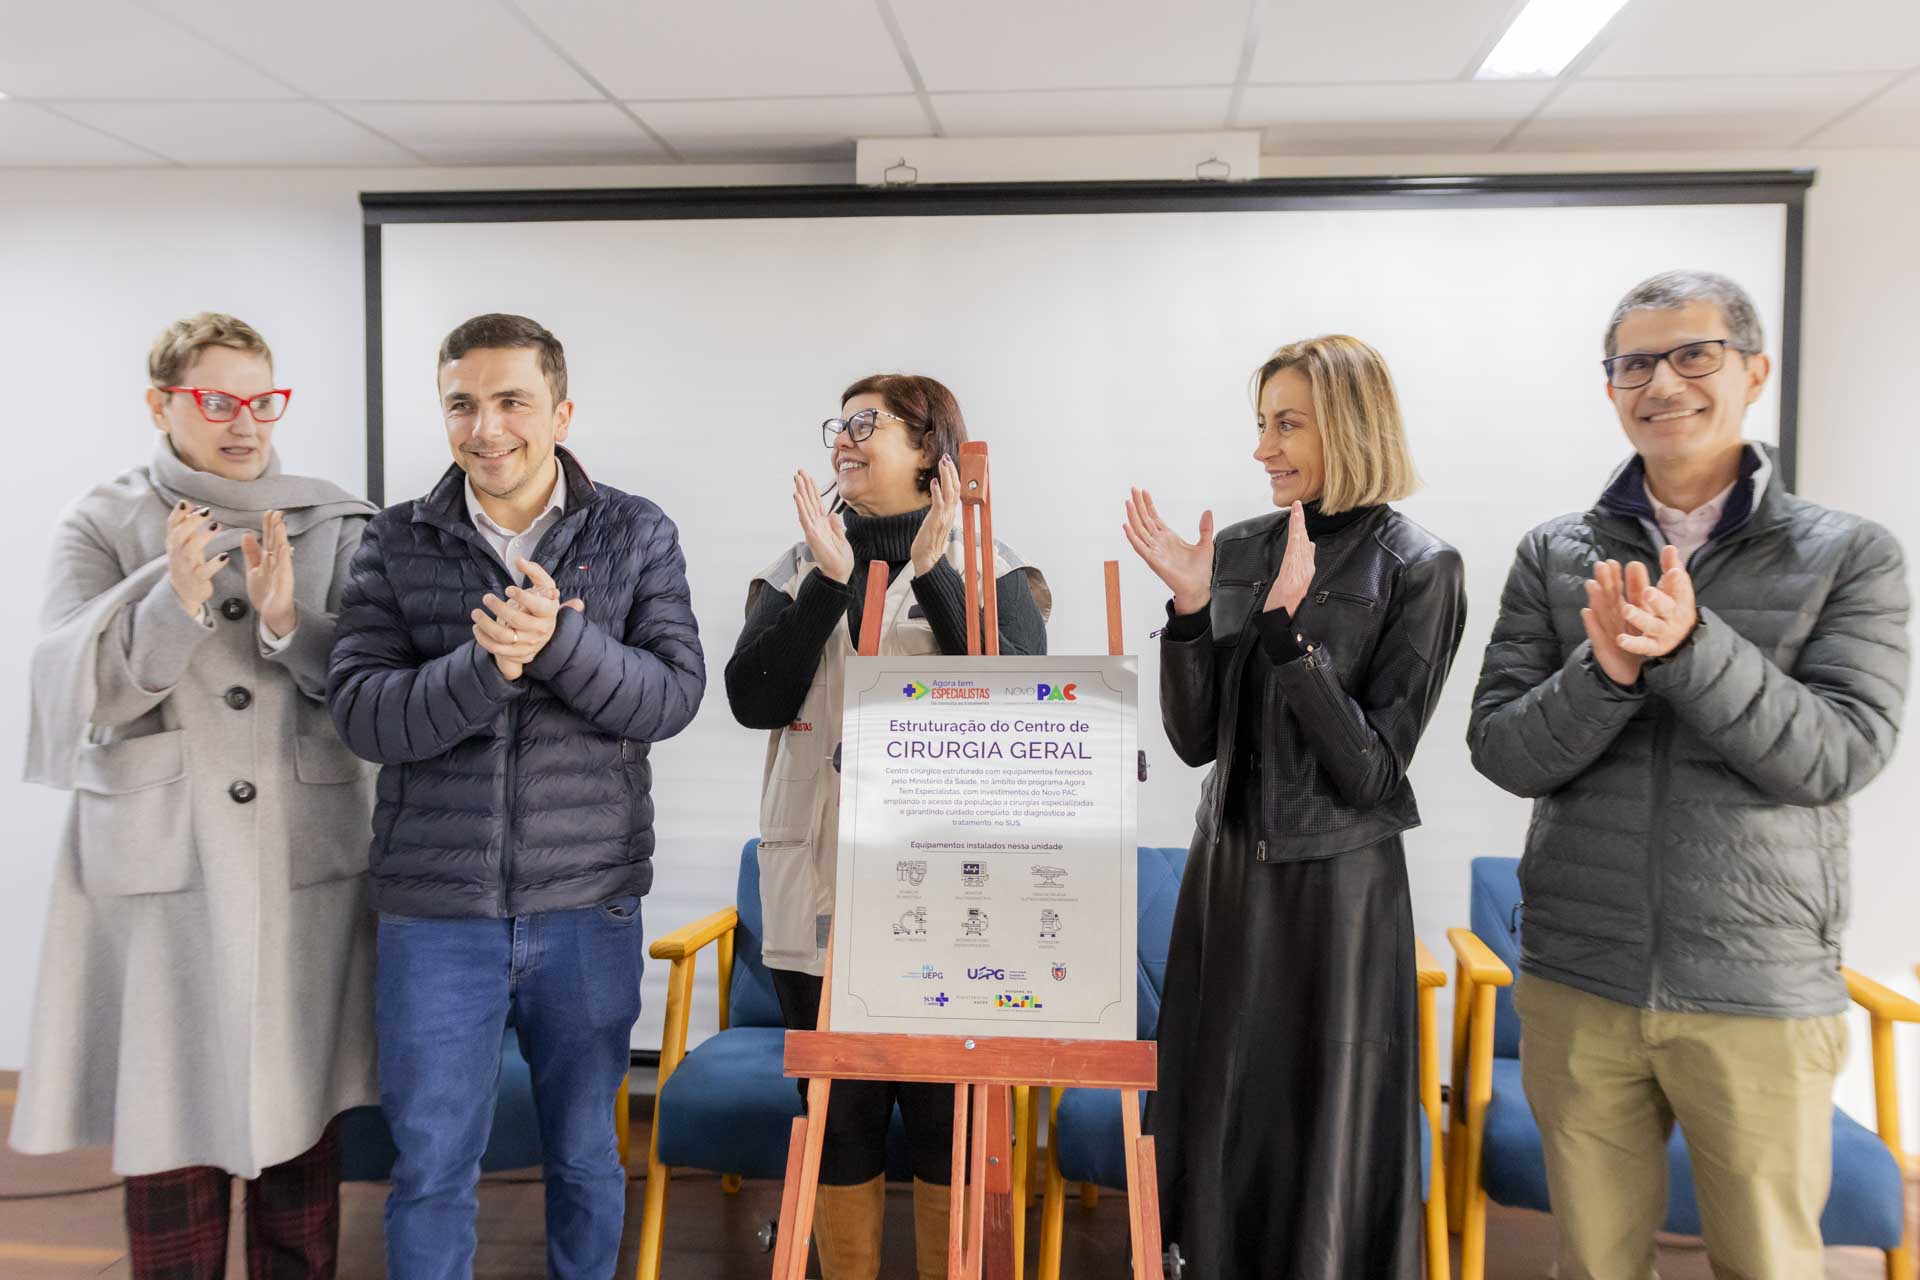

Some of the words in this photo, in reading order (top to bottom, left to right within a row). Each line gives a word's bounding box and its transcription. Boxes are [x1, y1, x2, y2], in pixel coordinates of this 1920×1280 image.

[932, 680, 956, 688] Agora
[931, 687, 990, 699] ESPECIALISTAS
[1005, 687, 1035, 696] NOVO
[1037, 683, 1077, 701] PAC
[890, 719, 986, 734] Estruturação
[990, 720, 1010, 733] do
[1014, 720, 1064, 733] Centro
[1069, 720, 1089, 733] de
[887, 741, 1003, 759] CIRURGIA
[1010, 741, 1092, 760] GERAL
[885, 767, 909, 775] Centro
[1002, 768, 1053, 776] equipamentos
[883, 798, 920, 806] ampliando
[964, 799, 1001, 807] população
[910, 841, 965, 849] Equipamentos
[966, 841, 1006, 849] instalados
[1031, 842, 1063, 850] unidade
[922, 972, 943, 980] UEPG
